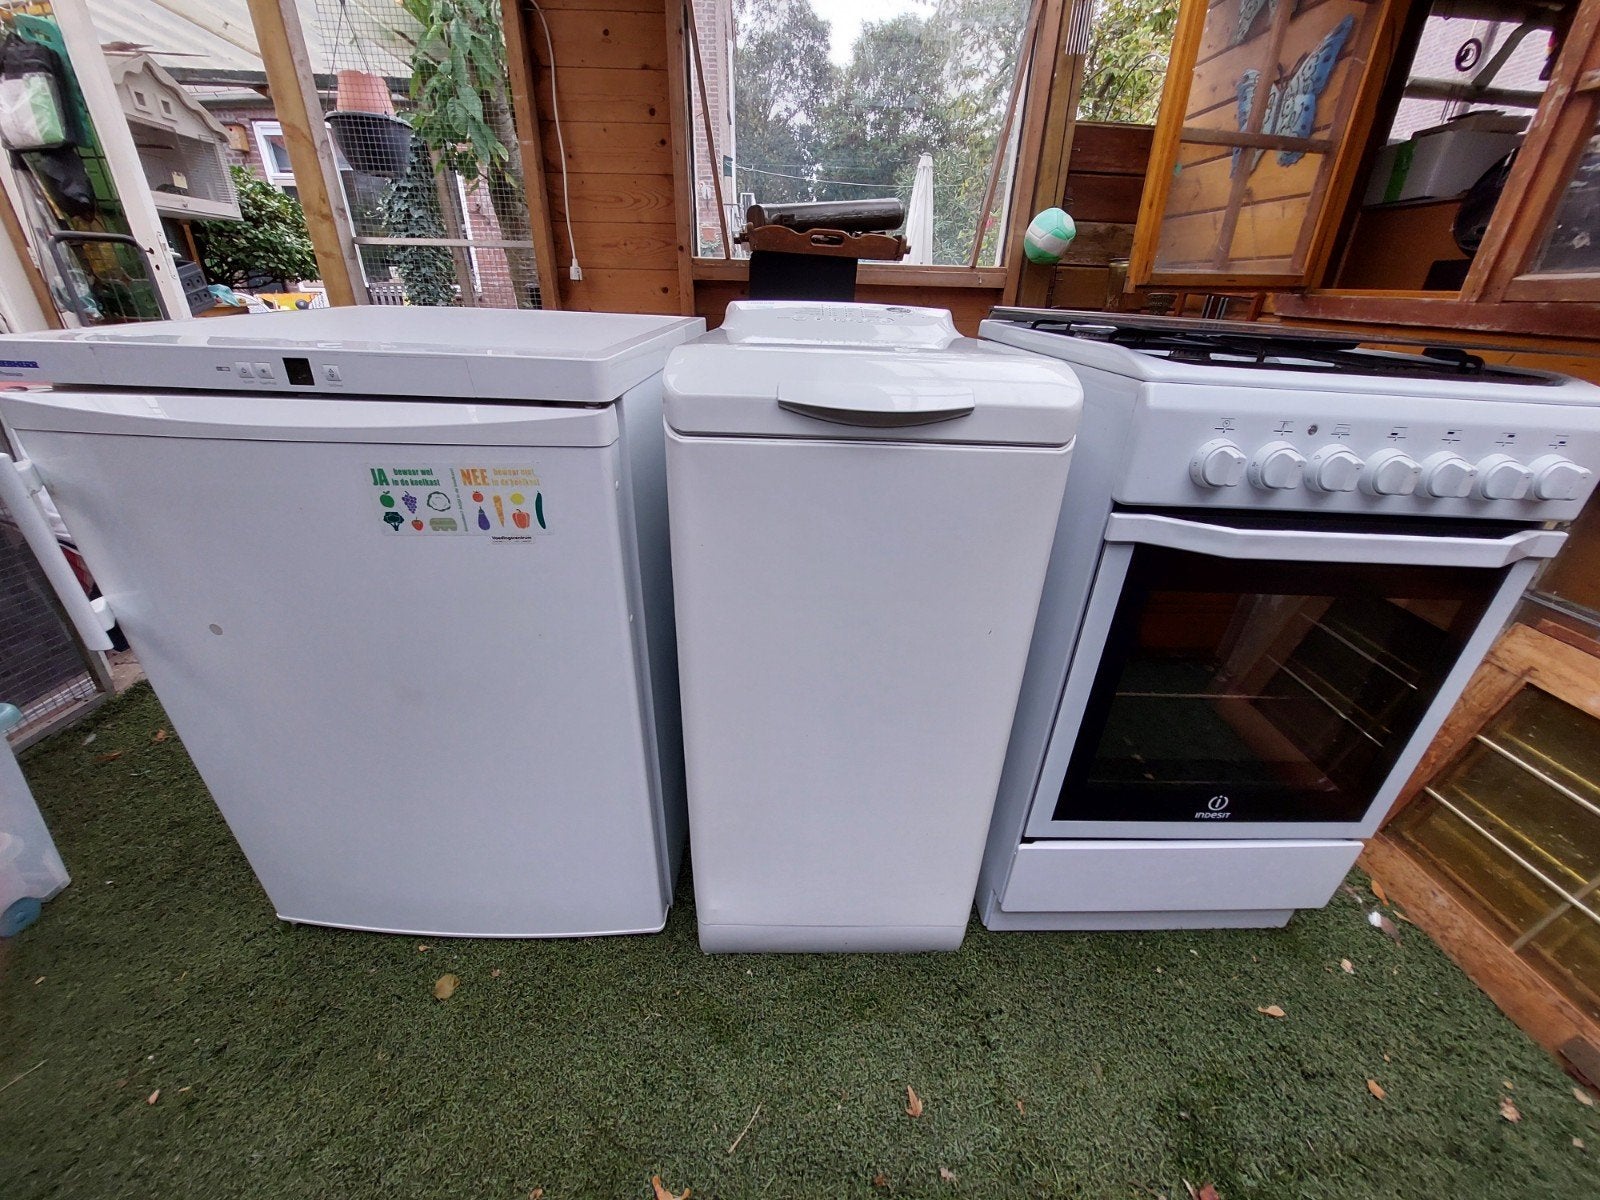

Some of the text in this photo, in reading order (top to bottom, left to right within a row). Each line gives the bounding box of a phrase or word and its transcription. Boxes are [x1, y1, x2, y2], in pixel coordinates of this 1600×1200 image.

[370, 467, 390, 486] JA
[393, 468, 419, 476] bewaar
[460, 468, 490, 486] NEE
